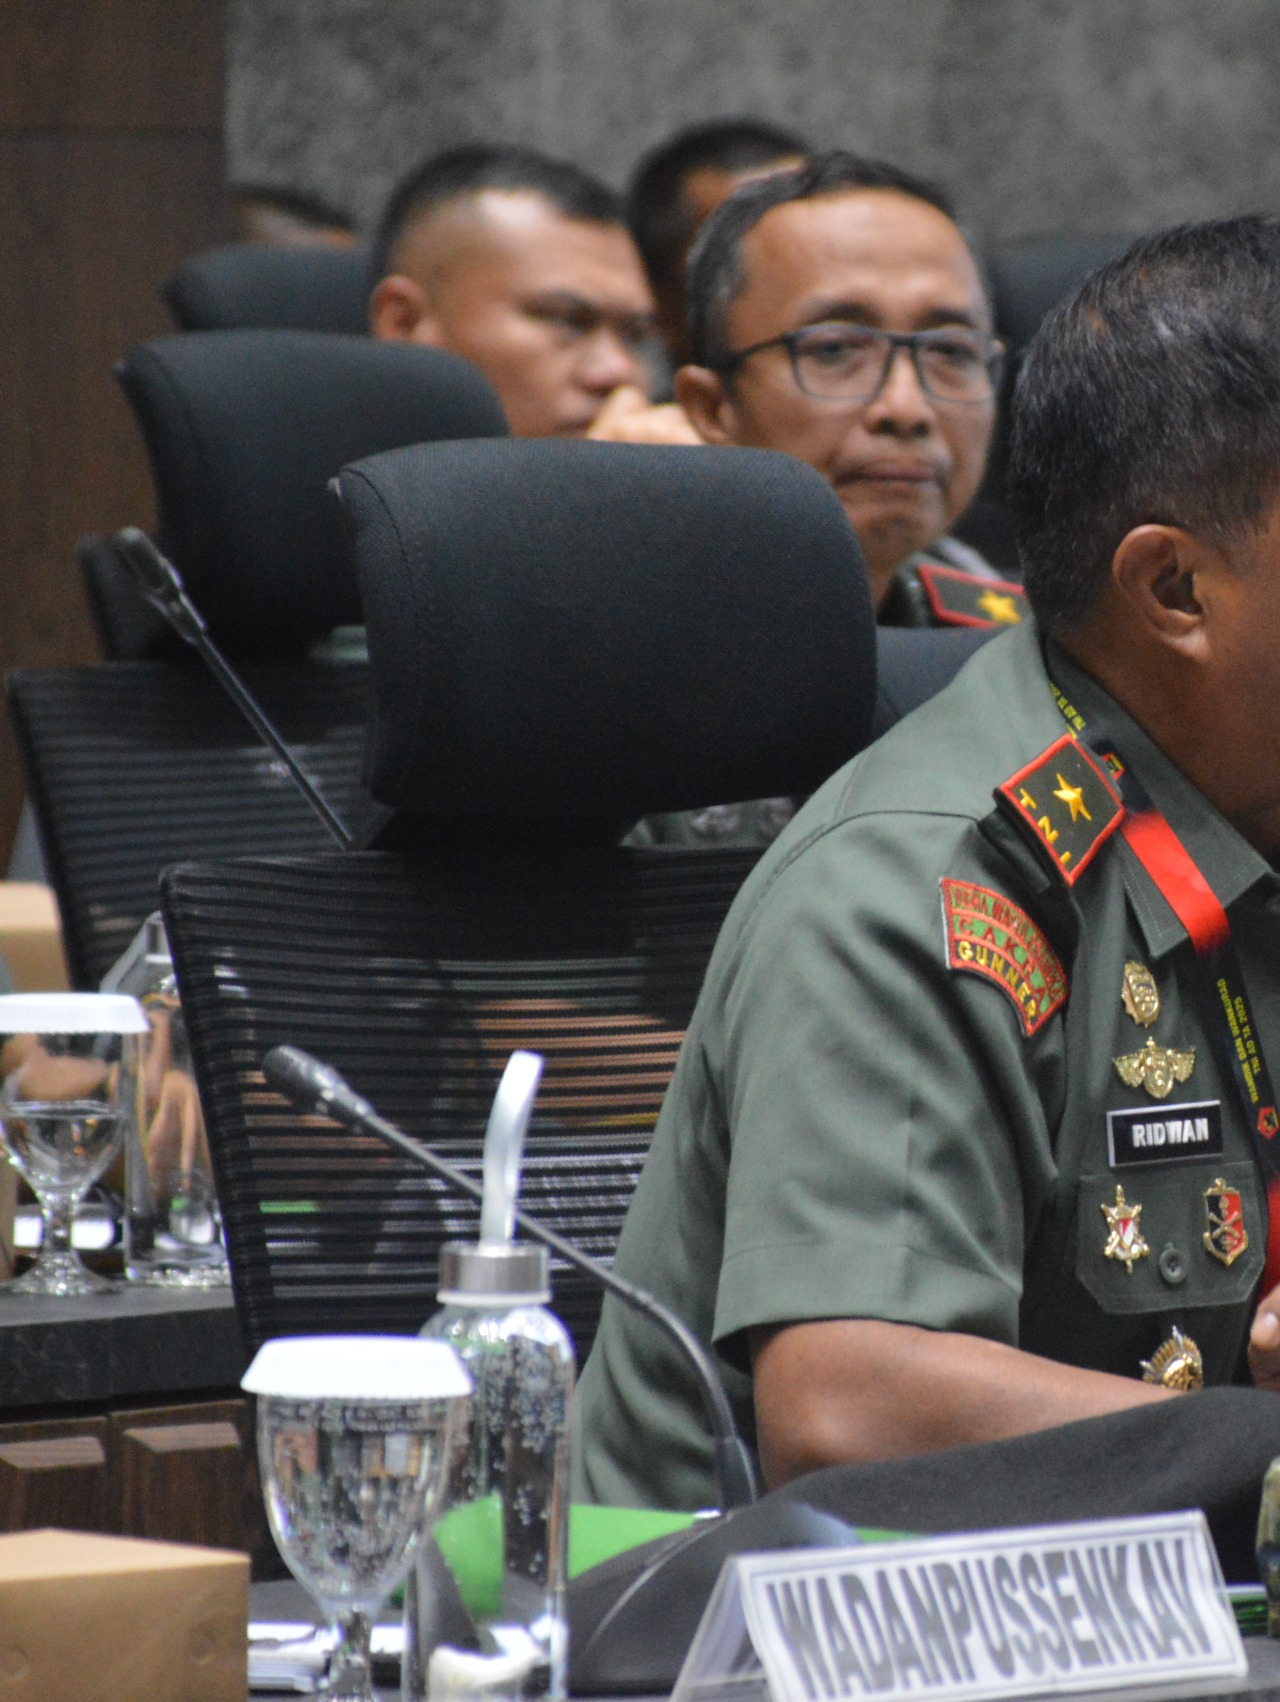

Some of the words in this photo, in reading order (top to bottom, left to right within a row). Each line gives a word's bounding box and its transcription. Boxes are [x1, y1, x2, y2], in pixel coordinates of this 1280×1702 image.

[1020, 788, 1072, 865] TNI
[958, 940, 1036, 1019] GUNNER
[1132, 1117, 1209, 1148] RIDWAN
[766, 1537, 1214, 1700] WADANPUSSENKAV
